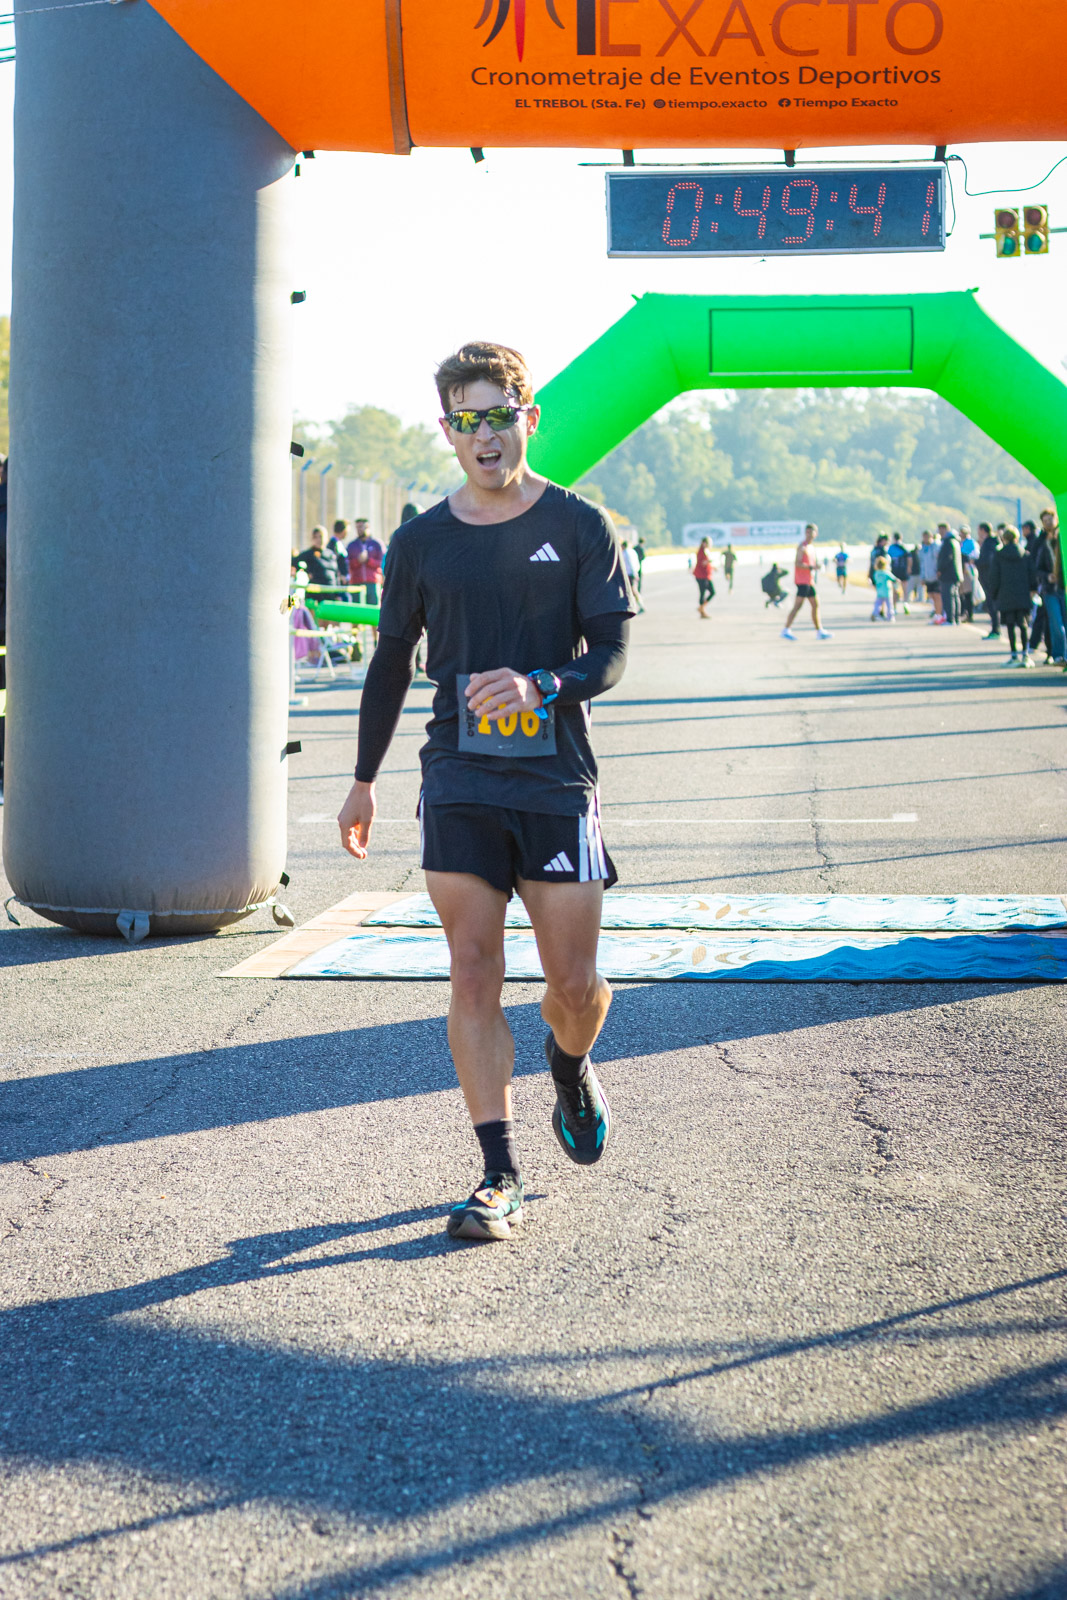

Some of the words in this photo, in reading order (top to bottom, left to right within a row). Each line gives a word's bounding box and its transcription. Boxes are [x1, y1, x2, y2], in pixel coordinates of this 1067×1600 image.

[471, 66, 643, 90] Cronometraje
[650, 66, 681, 86] de
[690, 66, 790, 86] Eventos
[798, 65, 941, 89] Deportivos
[515, 99, 531, 108] EL
[533, 99, 588, 108] TREBOL
[591, 98, 622, 109] (Sta.
[625, 98, 646, 109] Fe)
[668, 98, 768, 110] tiempo.exacto
[793, 97, 848, 109] Tiempo
[852, 97, 898, 108] Exacto
[662, 179, 934, 247] 0:49:41
